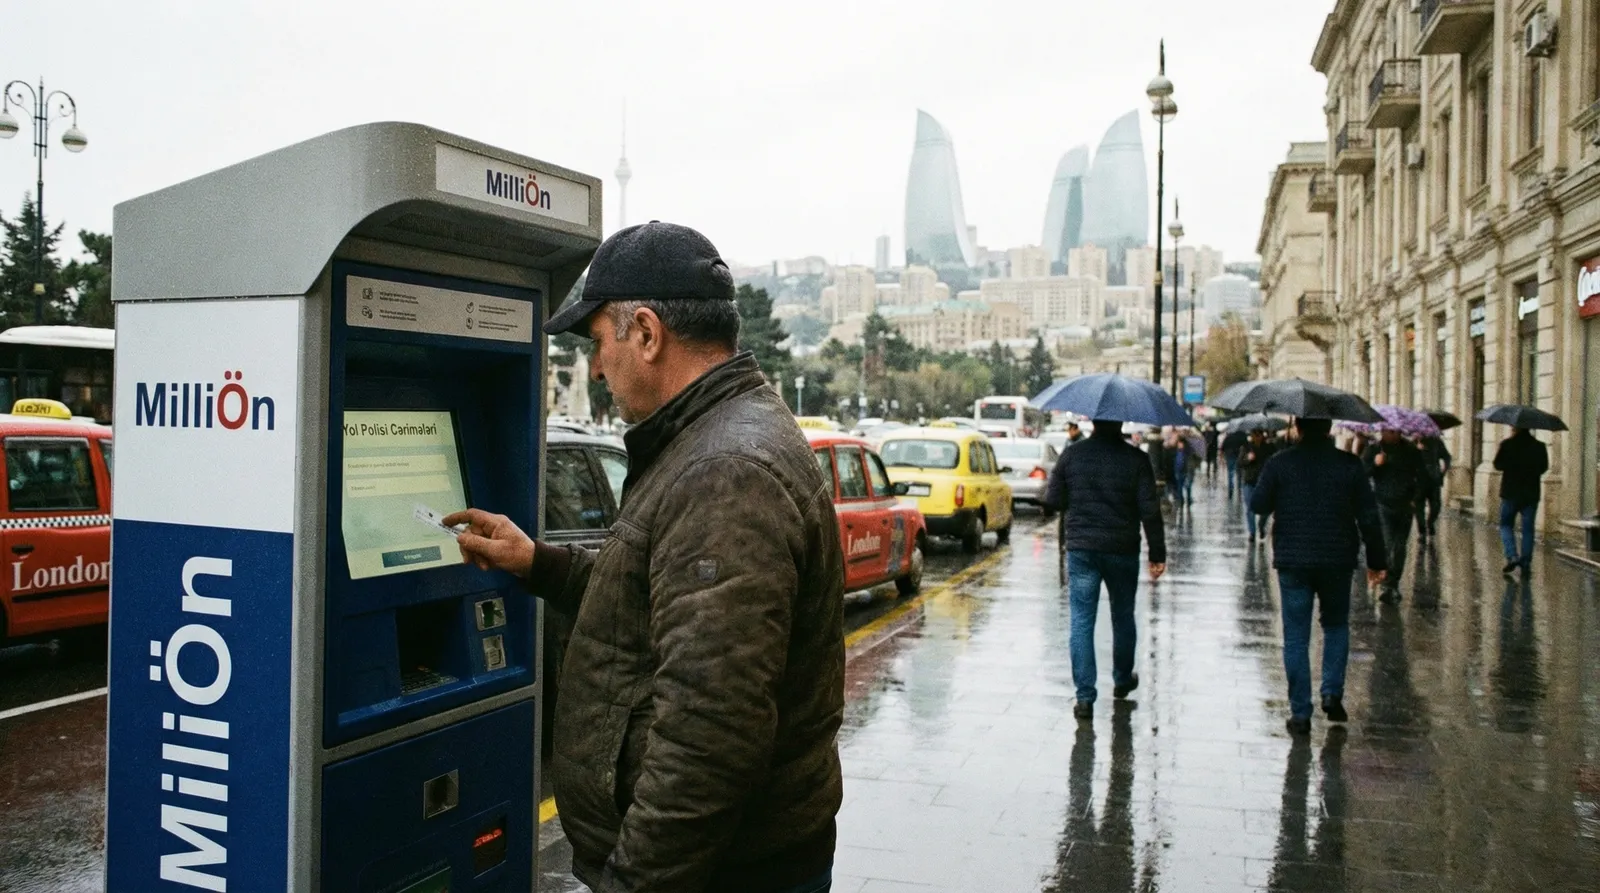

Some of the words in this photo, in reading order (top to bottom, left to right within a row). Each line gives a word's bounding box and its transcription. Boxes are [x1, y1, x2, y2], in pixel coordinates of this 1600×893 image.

[486, 169, 551, 210] MilliÖn
[135, 370, 275, 430] MilliÖn
[343, 423, 359, 436] Yol
[361, 423, 389, 436] Polisi
[390, 423, 437, 436] Cərimələri
[150, 556, 233, 893] MiliÖn
